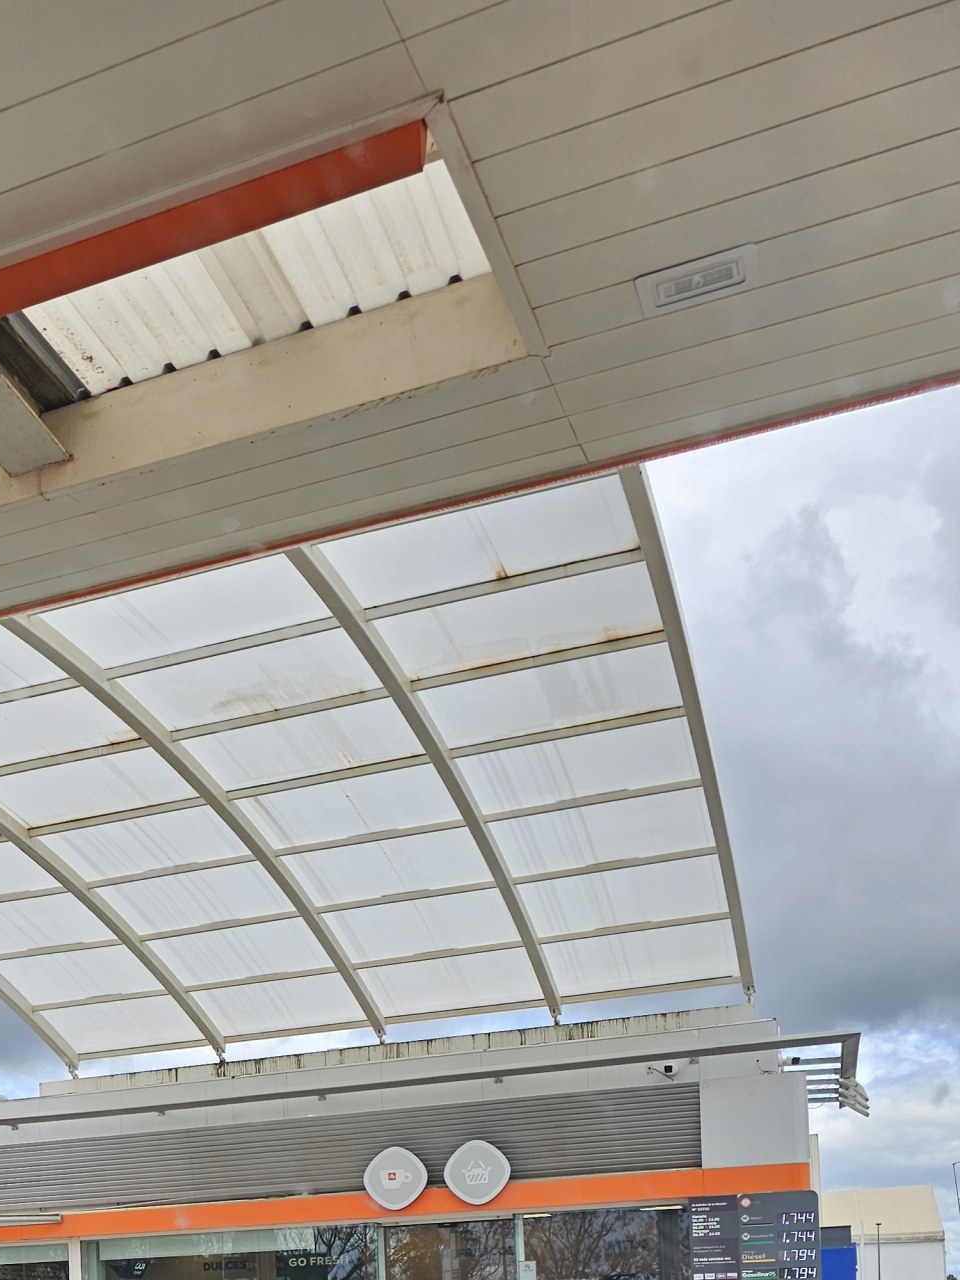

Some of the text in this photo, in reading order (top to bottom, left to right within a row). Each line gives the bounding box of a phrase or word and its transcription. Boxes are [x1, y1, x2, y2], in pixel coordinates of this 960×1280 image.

[782, 1212, 815, 1225] 1.744
[782, 1231, 816, 1243] 1.744
[783, 1249, 816, 1262] 1.794
[203, 1260, 247, 1271] DULCES
[289, 1257, 306, 1267] GO
[784, 1267, 817, 1280] 1.794
